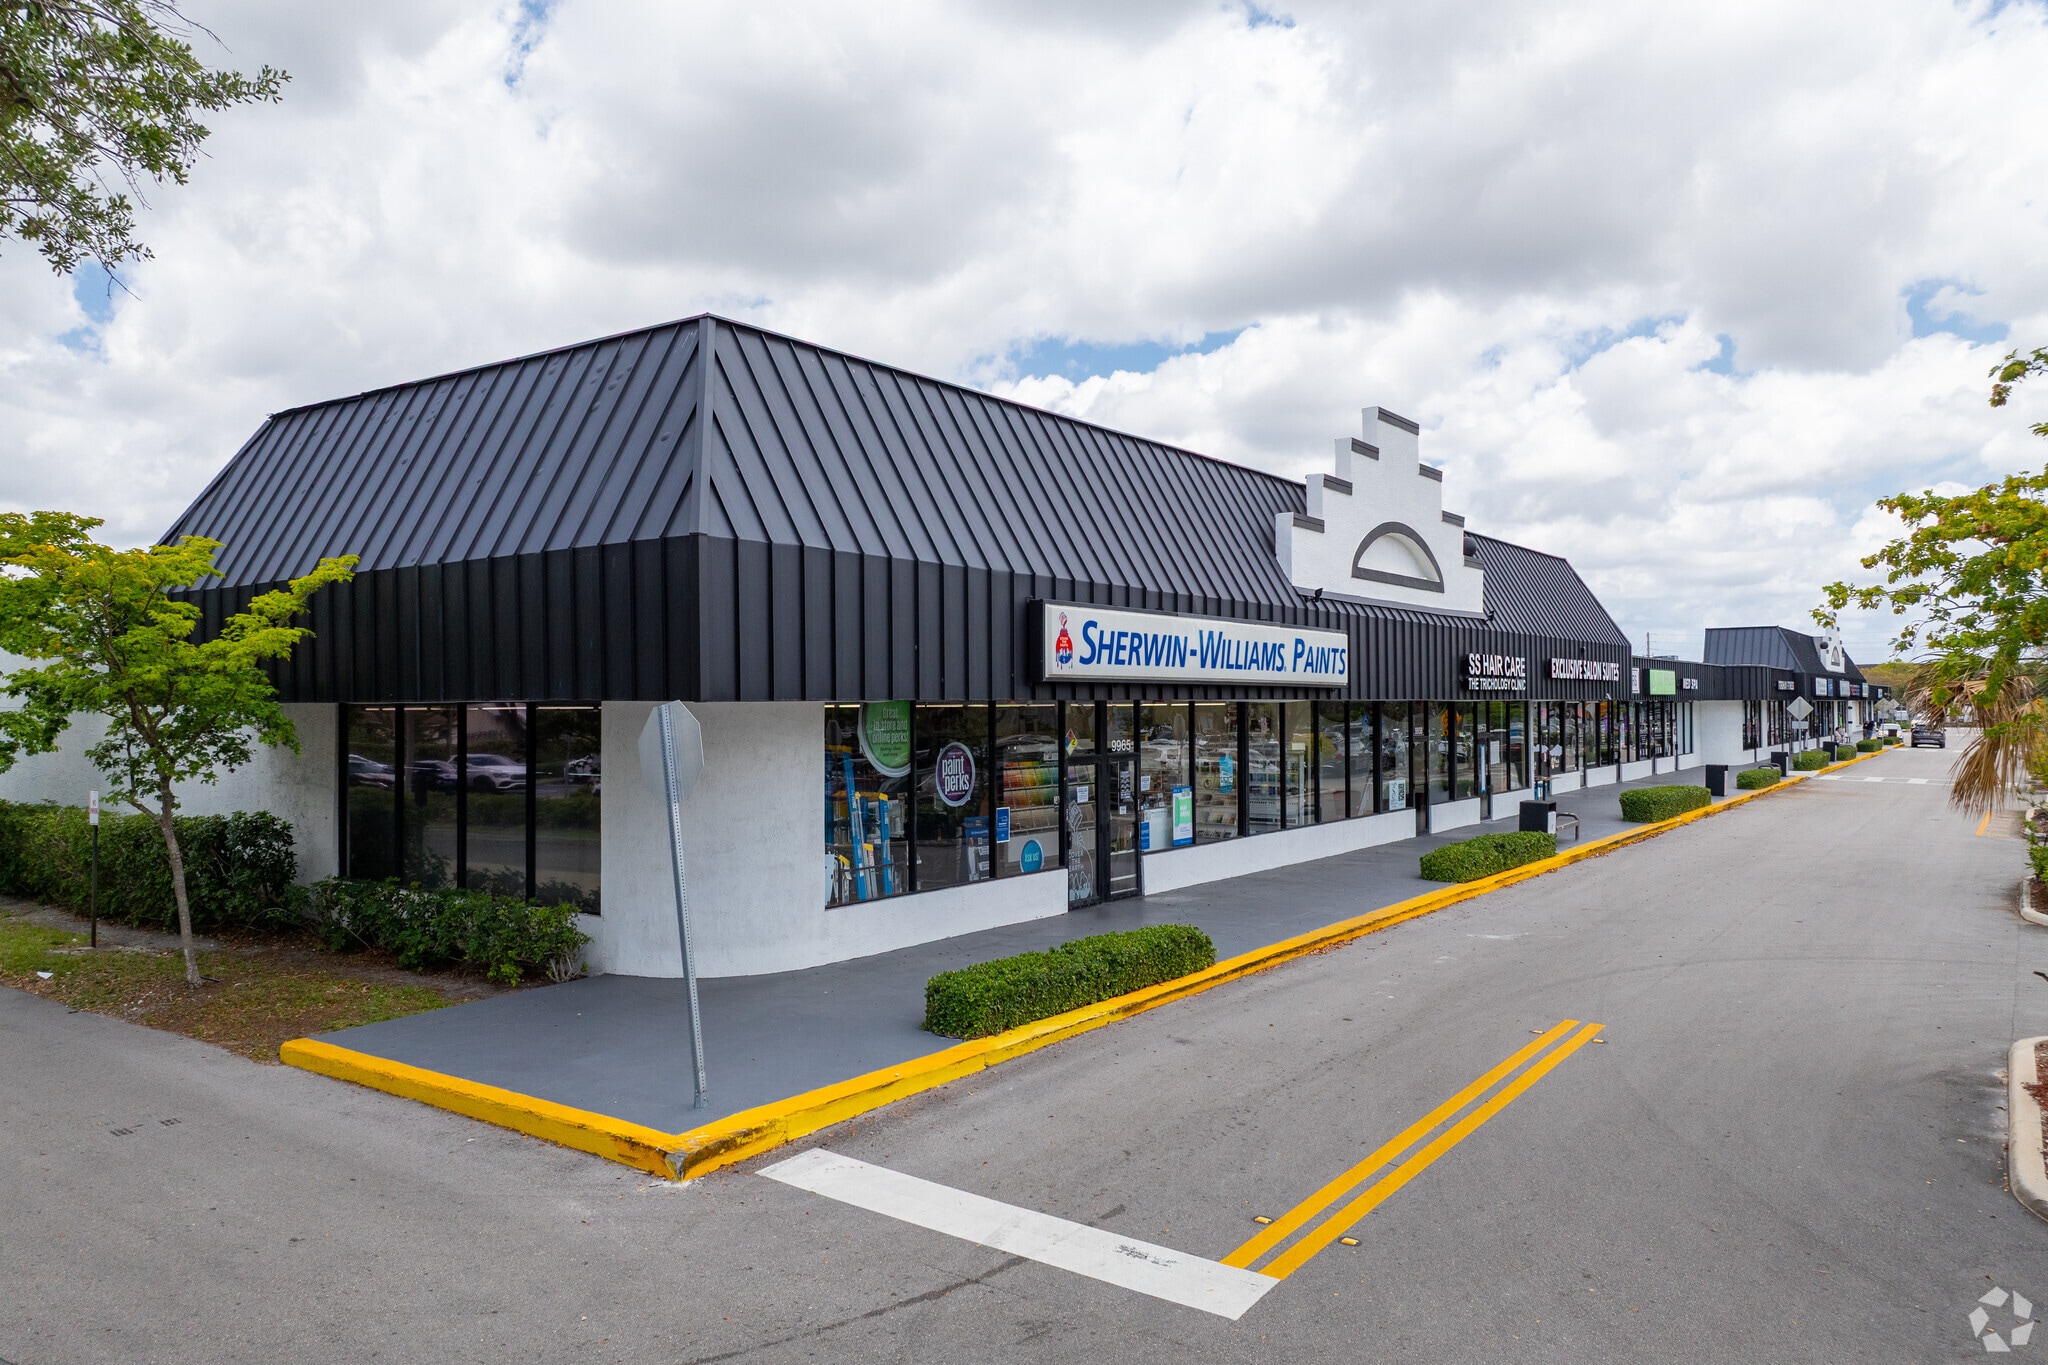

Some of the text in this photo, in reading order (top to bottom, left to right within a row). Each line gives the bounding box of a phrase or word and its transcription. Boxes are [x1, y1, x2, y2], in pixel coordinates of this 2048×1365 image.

[1292, 638, 1346, 675] PAINTS
[1468, 652, 1526, 677] SS HAIR CARE
[1551, 658, 1619, 682] EXCLUSIVE SALON SUITES
[1468, 677, 1526, 691] THE TRICHOLOGY CLINIC
[882, 707, 899, 719] Great
[896, 720, 908, 731] and
[872, 731, 891, 744] online
[1111, 739, 1131, 752] 9965
[942, 755, 965, 778] paint
[945, 773, 970, 795] perks
